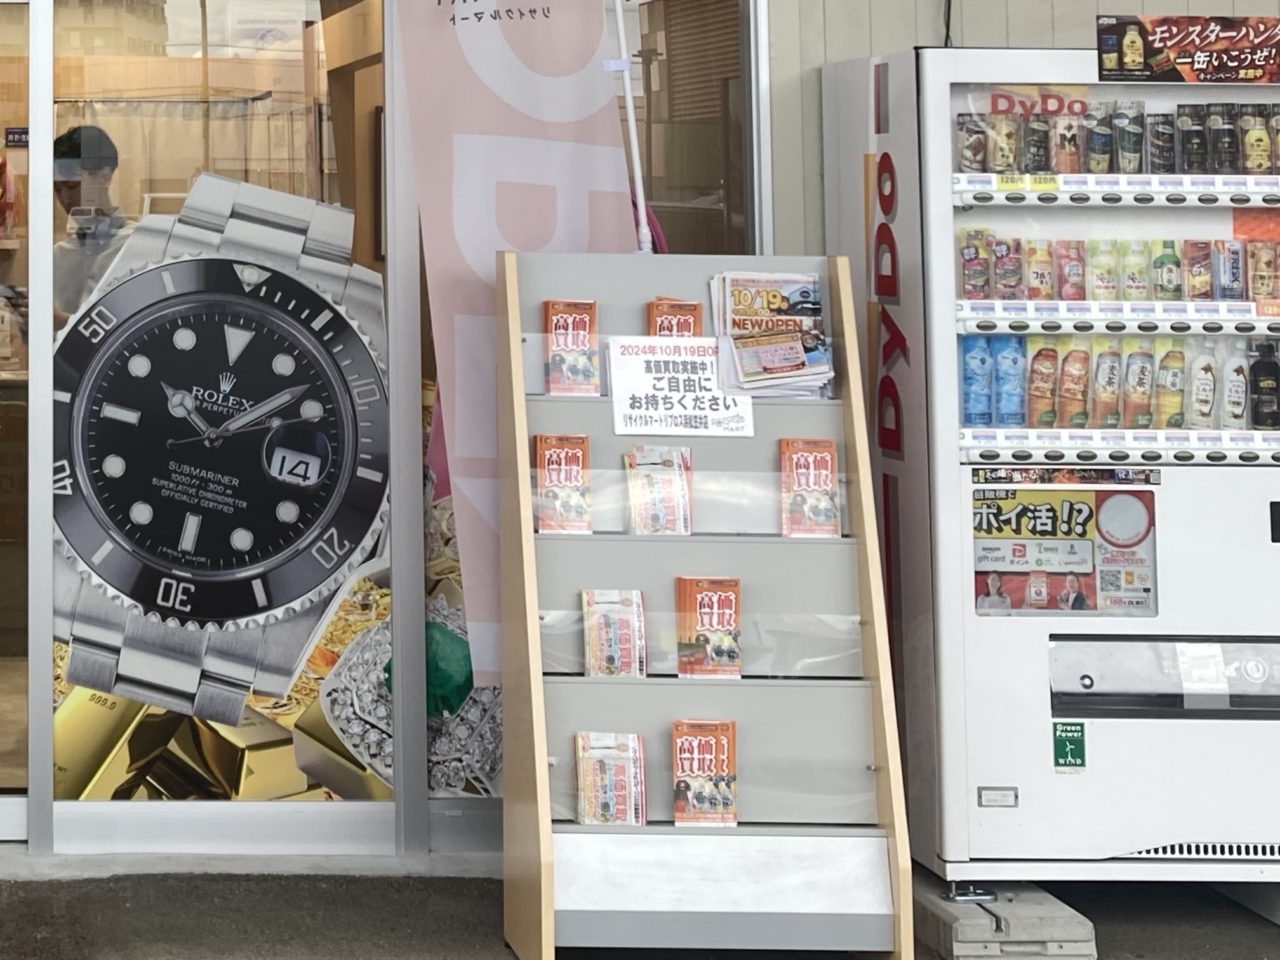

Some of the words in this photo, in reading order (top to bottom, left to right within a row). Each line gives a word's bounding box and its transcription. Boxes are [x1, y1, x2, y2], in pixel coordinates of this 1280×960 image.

[1176, 48, 1277, 70] 一缶いこうぜ!
[991, 92, 1088, 123] DyDo
[78, 306, 117, 343] 50
[553, 315, 590, 333] 高価
[732, 318, 765, 330] NEW
[765, 319, 803, 332] OPEN
[652, 376, 713, 393] ご自由に
[191, 386, 254, 411] ROLEX
[629, 393, 738, 412] お持ちください
[278, 454, 311, 483] 14
[545, 449, 583, 468] 高価
[793, 453, 832, 471] 高価
[168, 460, 240, 487] SUBMARINER
[151, 477, 198, 496] SUPERLATIVE
[198, 490, 248, 509] CHRONOMETER
[160, 489, 199, 504] OFFICIALLY
[199, 499, 234, 514] CERTIFIED
[973, 500, 1093, 535] ポイ活!?
[312, 530, 354, 570] 20
[156, 577, 195, 613] 30
[696, 592, 737, 611] 高価
[677, 736, 716, 756] 高価
